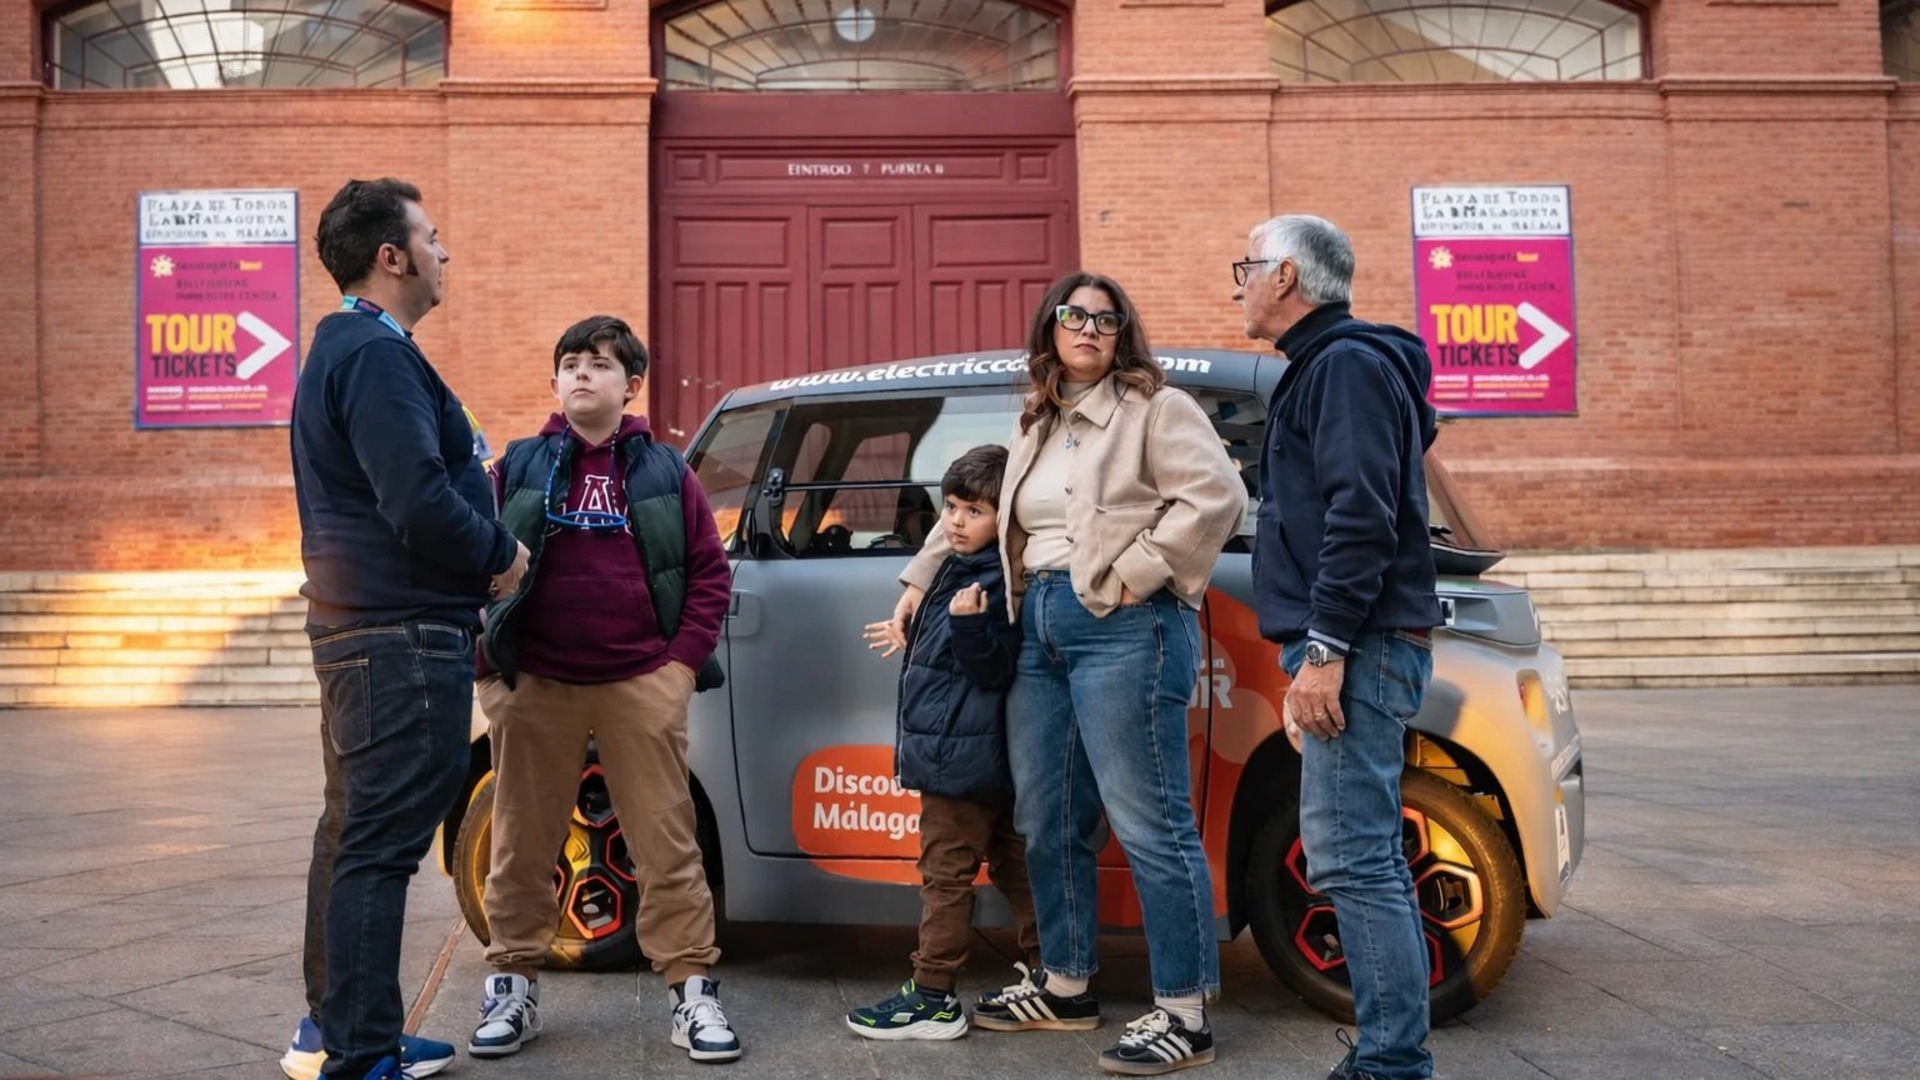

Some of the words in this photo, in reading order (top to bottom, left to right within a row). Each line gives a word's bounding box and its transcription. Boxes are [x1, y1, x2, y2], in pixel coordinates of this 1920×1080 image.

[145, 313, 237, 355] TOUR
[1430, 303, 1519, 345] TOUR
[152, 353, 237, 378] TICKETS
[1437, 343, 1520, 367] TICKETS
[813, 800, 921, 840] Málaga
